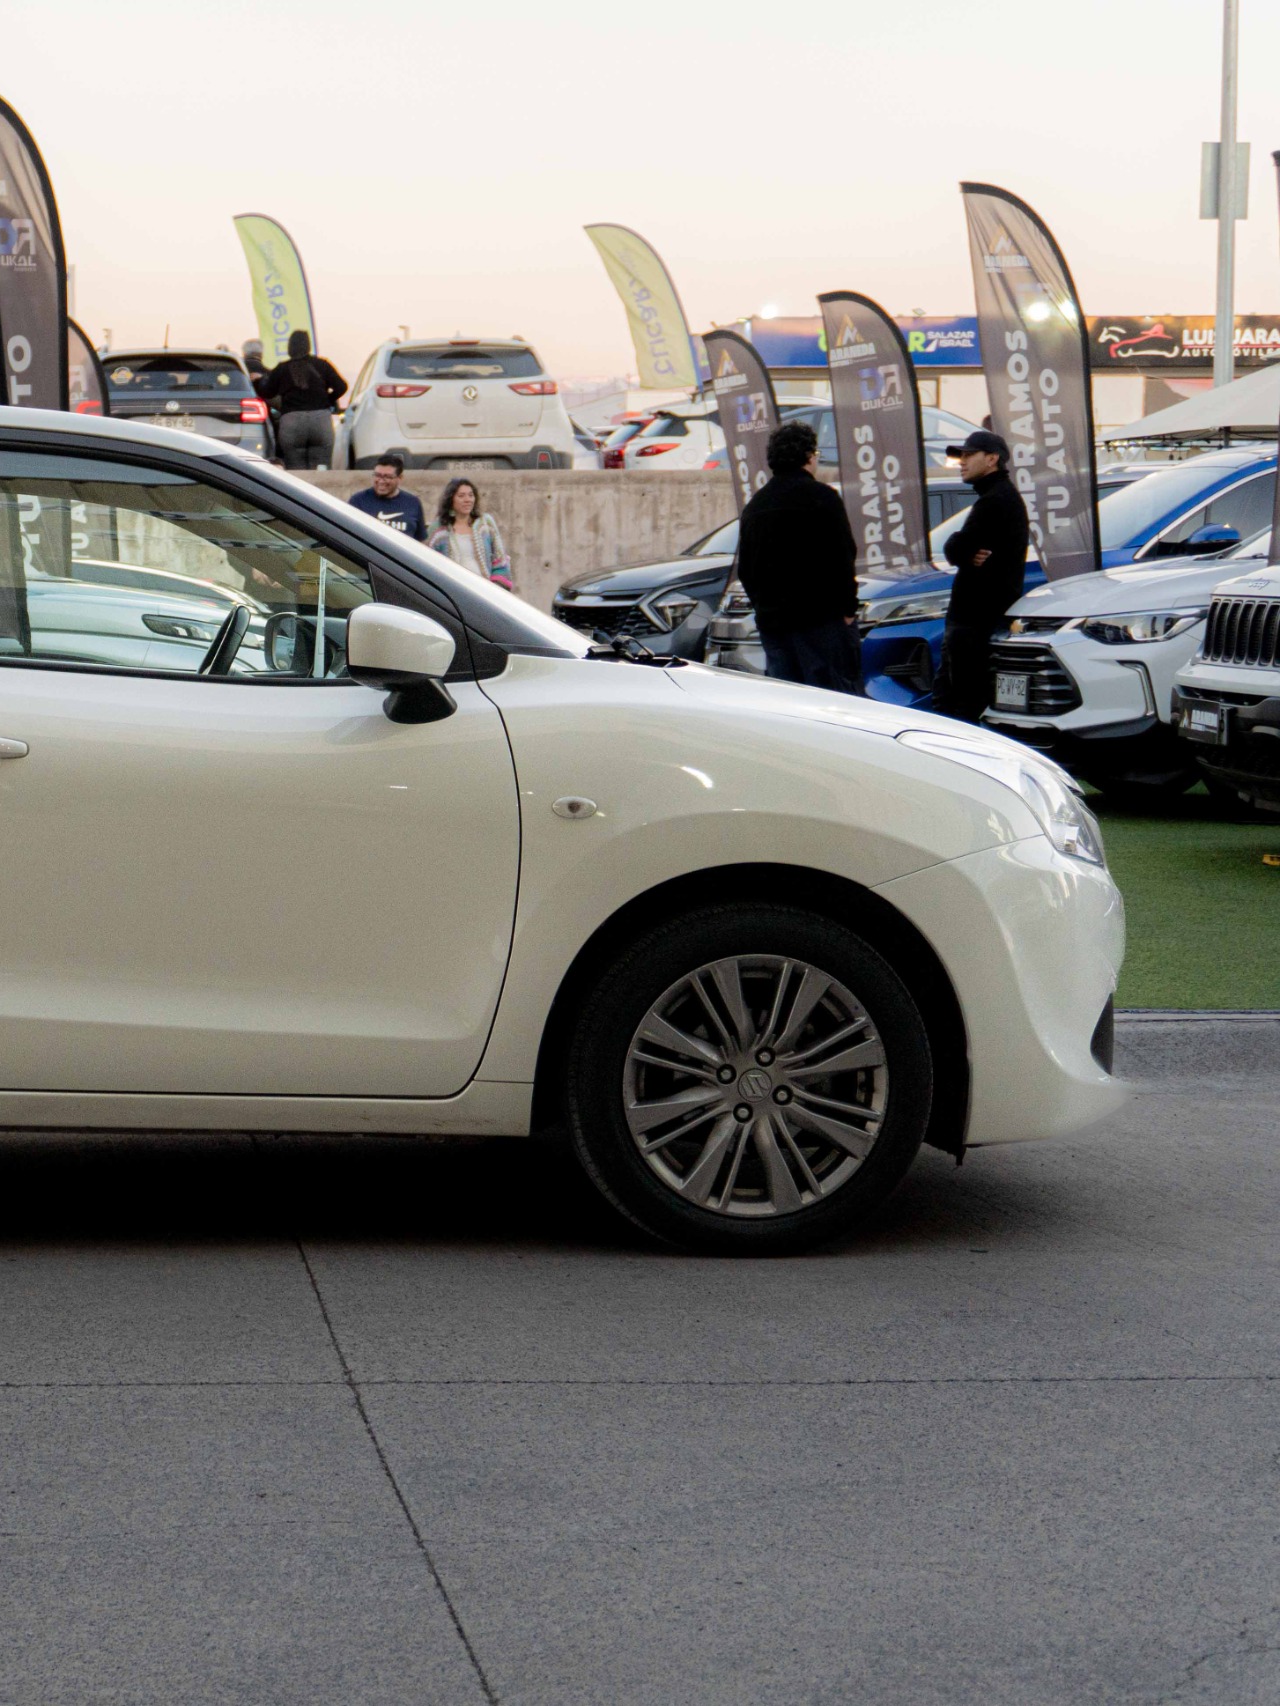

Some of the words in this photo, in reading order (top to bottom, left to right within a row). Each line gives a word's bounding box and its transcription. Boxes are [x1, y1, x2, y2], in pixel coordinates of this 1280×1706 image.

[927, 330, 976, 341] SALAZAR
[939, 338, 975, 349] ISRAEL
[6, 334, 33, 405] TO
[1039, 368, 1068, 474] AUTO
[1047, 485, 1071, 535] TU
